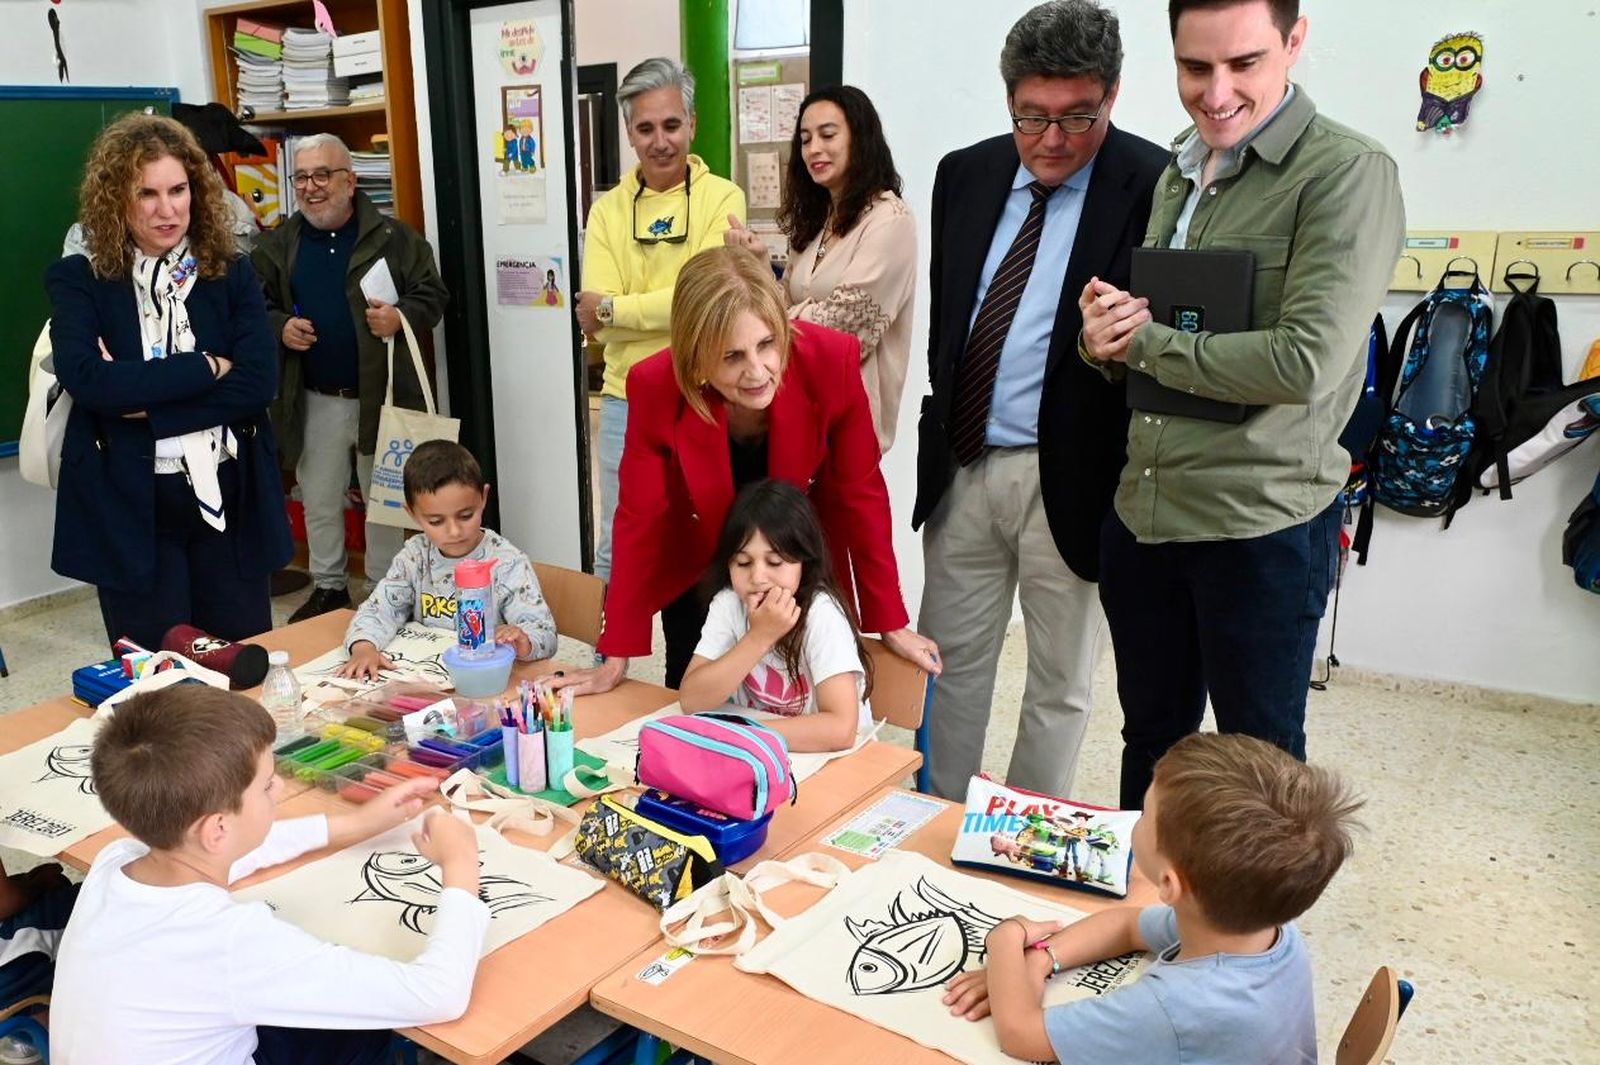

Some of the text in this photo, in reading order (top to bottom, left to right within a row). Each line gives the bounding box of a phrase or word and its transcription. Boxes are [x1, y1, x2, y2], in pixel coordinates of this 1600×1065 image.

[496, 260, 536, 269] EMERGENCIA
[985, 796, 1060, 817] PLAY
[5, 809, 48, 829] JEREZ
[963, 813, 1022, 833] TIME
[1075, 960, 1124, 995] JEREZ
